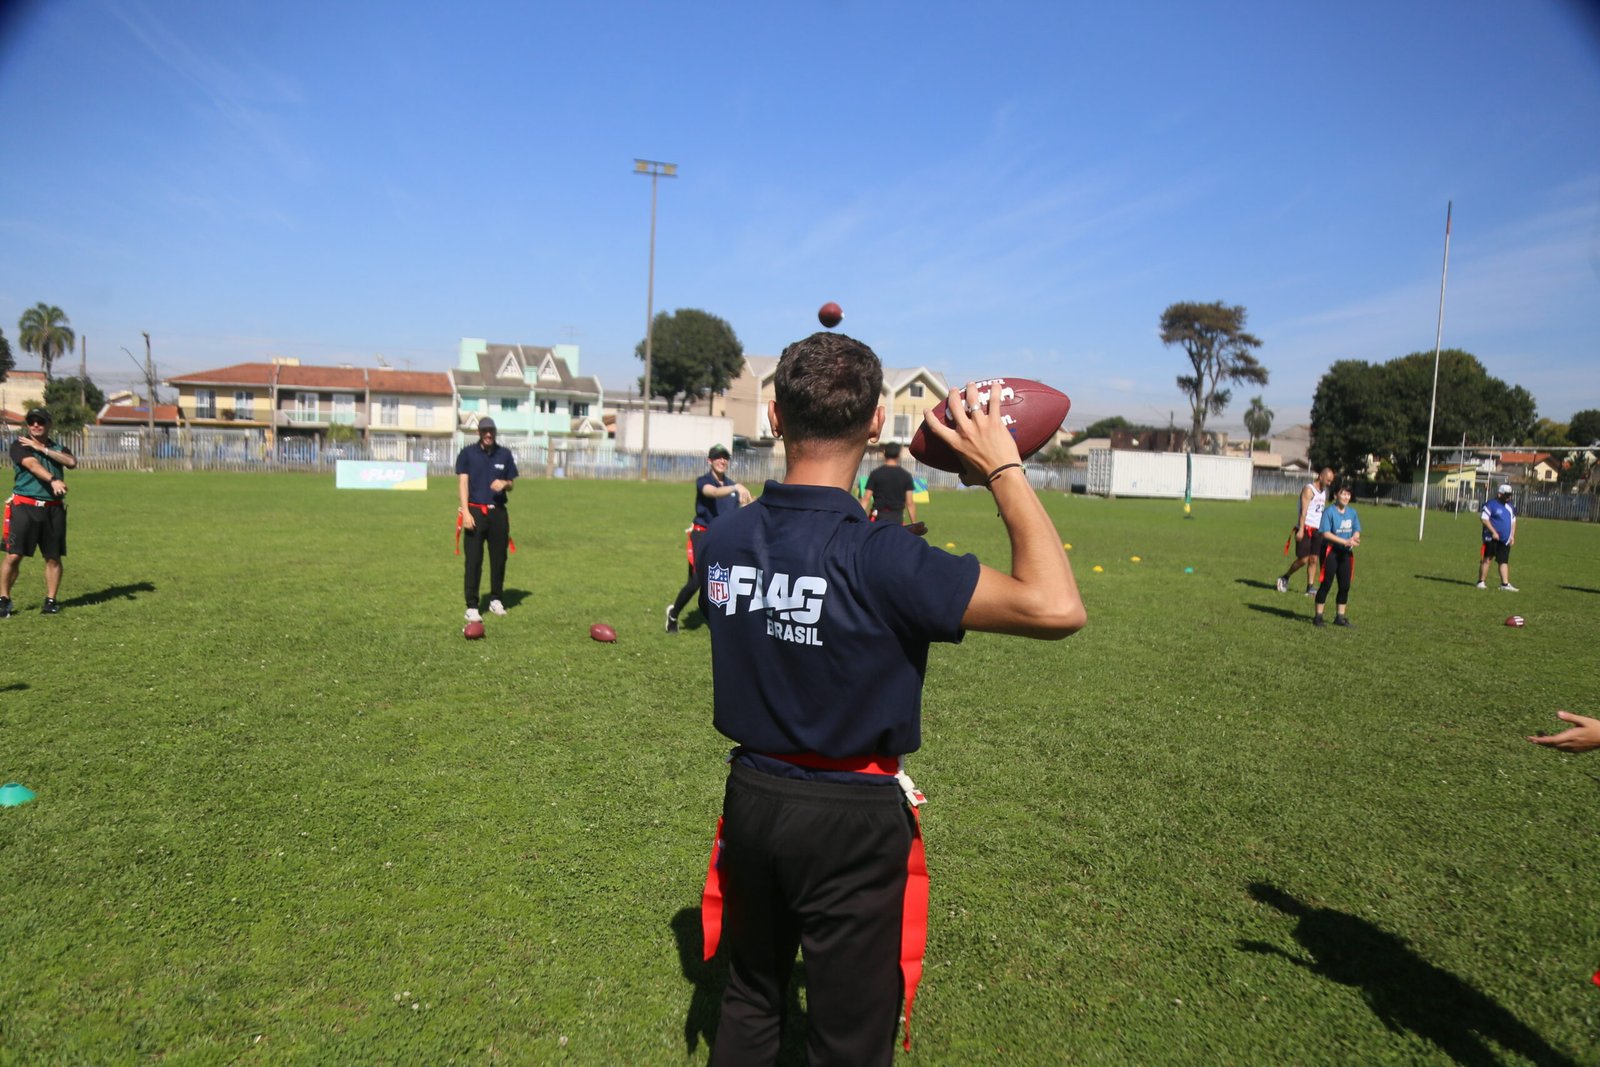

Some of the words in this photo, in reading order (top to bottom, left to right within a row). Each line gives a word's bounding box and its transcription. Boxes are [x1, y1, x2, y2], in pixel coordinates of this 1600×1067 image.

[709, 581, 728, 601] NFL
[726, 565, 828, 625] FLAG
[766, 618, 823, 646] BRASIL
